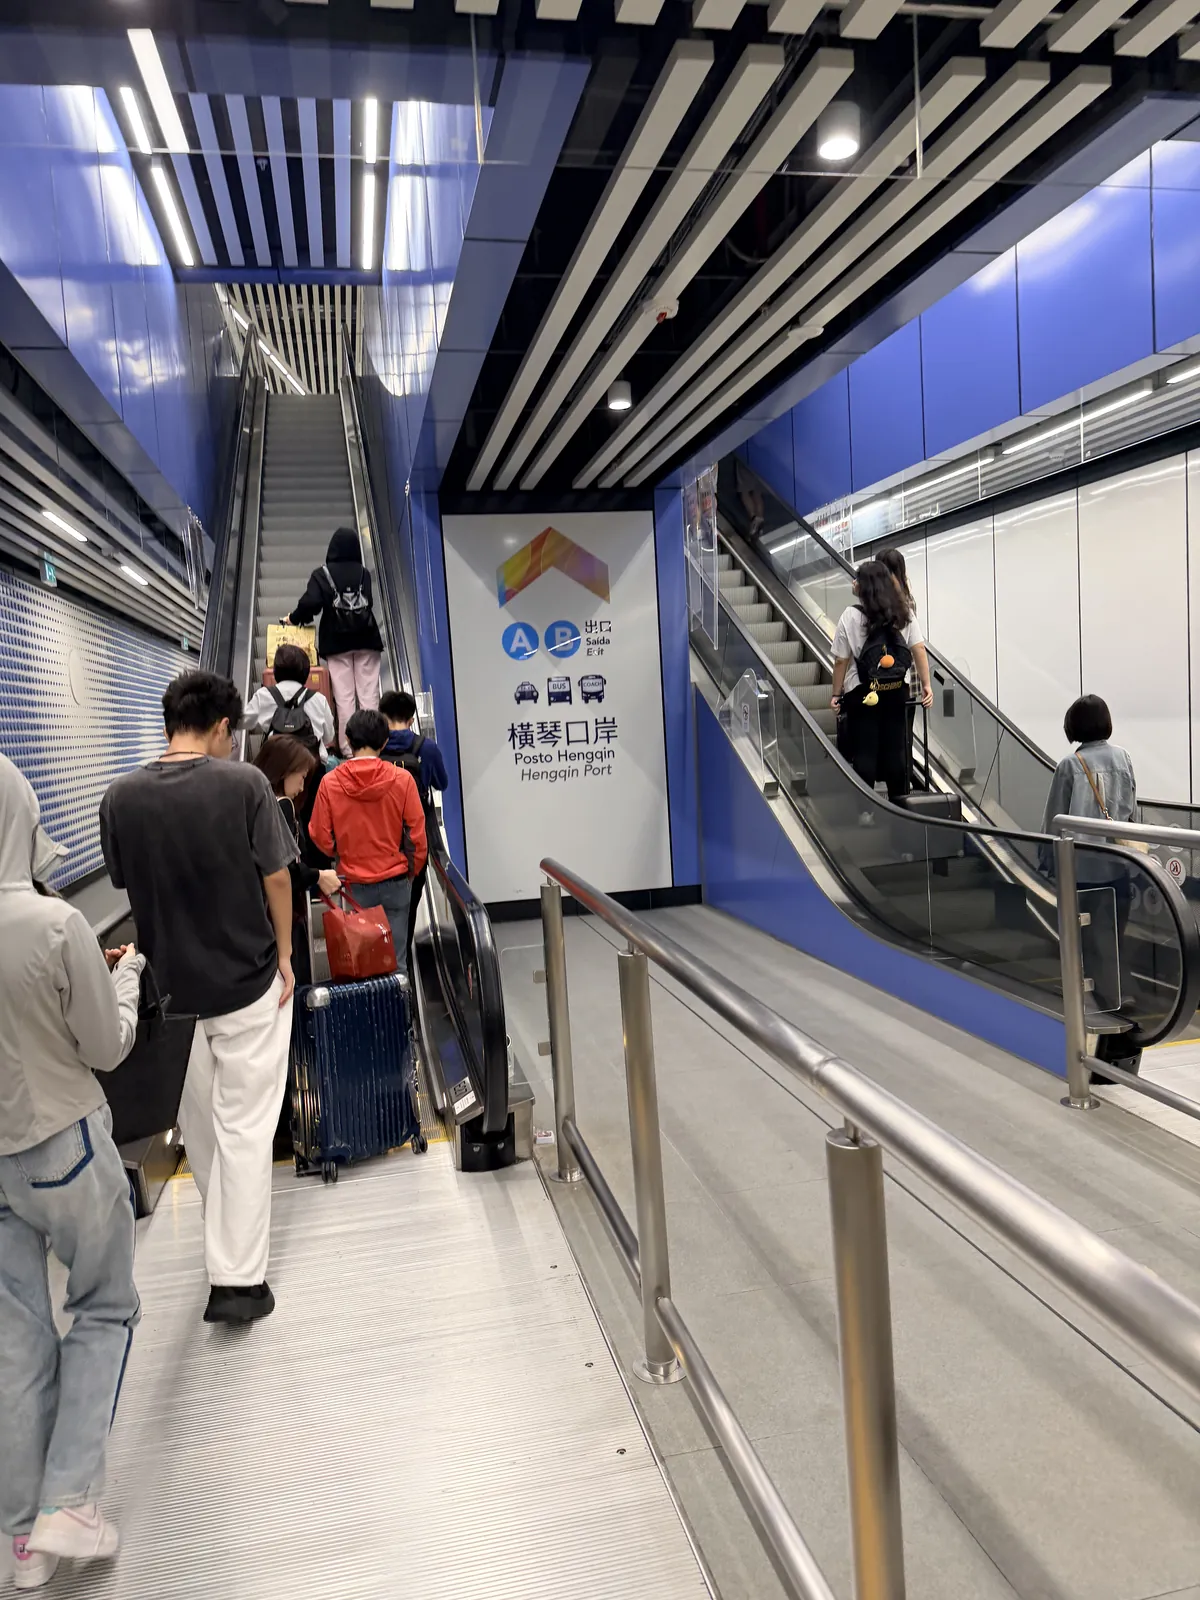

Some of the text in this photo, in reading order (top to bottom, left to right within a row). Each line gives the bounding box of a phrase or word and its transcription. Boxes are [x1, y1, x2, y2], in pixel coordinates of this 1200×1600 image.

[585, 620, 612, 634] 出口
[509, 627, 574, 653] A B
[586, 635, 611, 646] Saída
[507, 716, 618, 750] 橫琴口岸
[514, 747, 615, 765] Posto Hengqin
[521, 764, 612, 783] Hengqin Port
